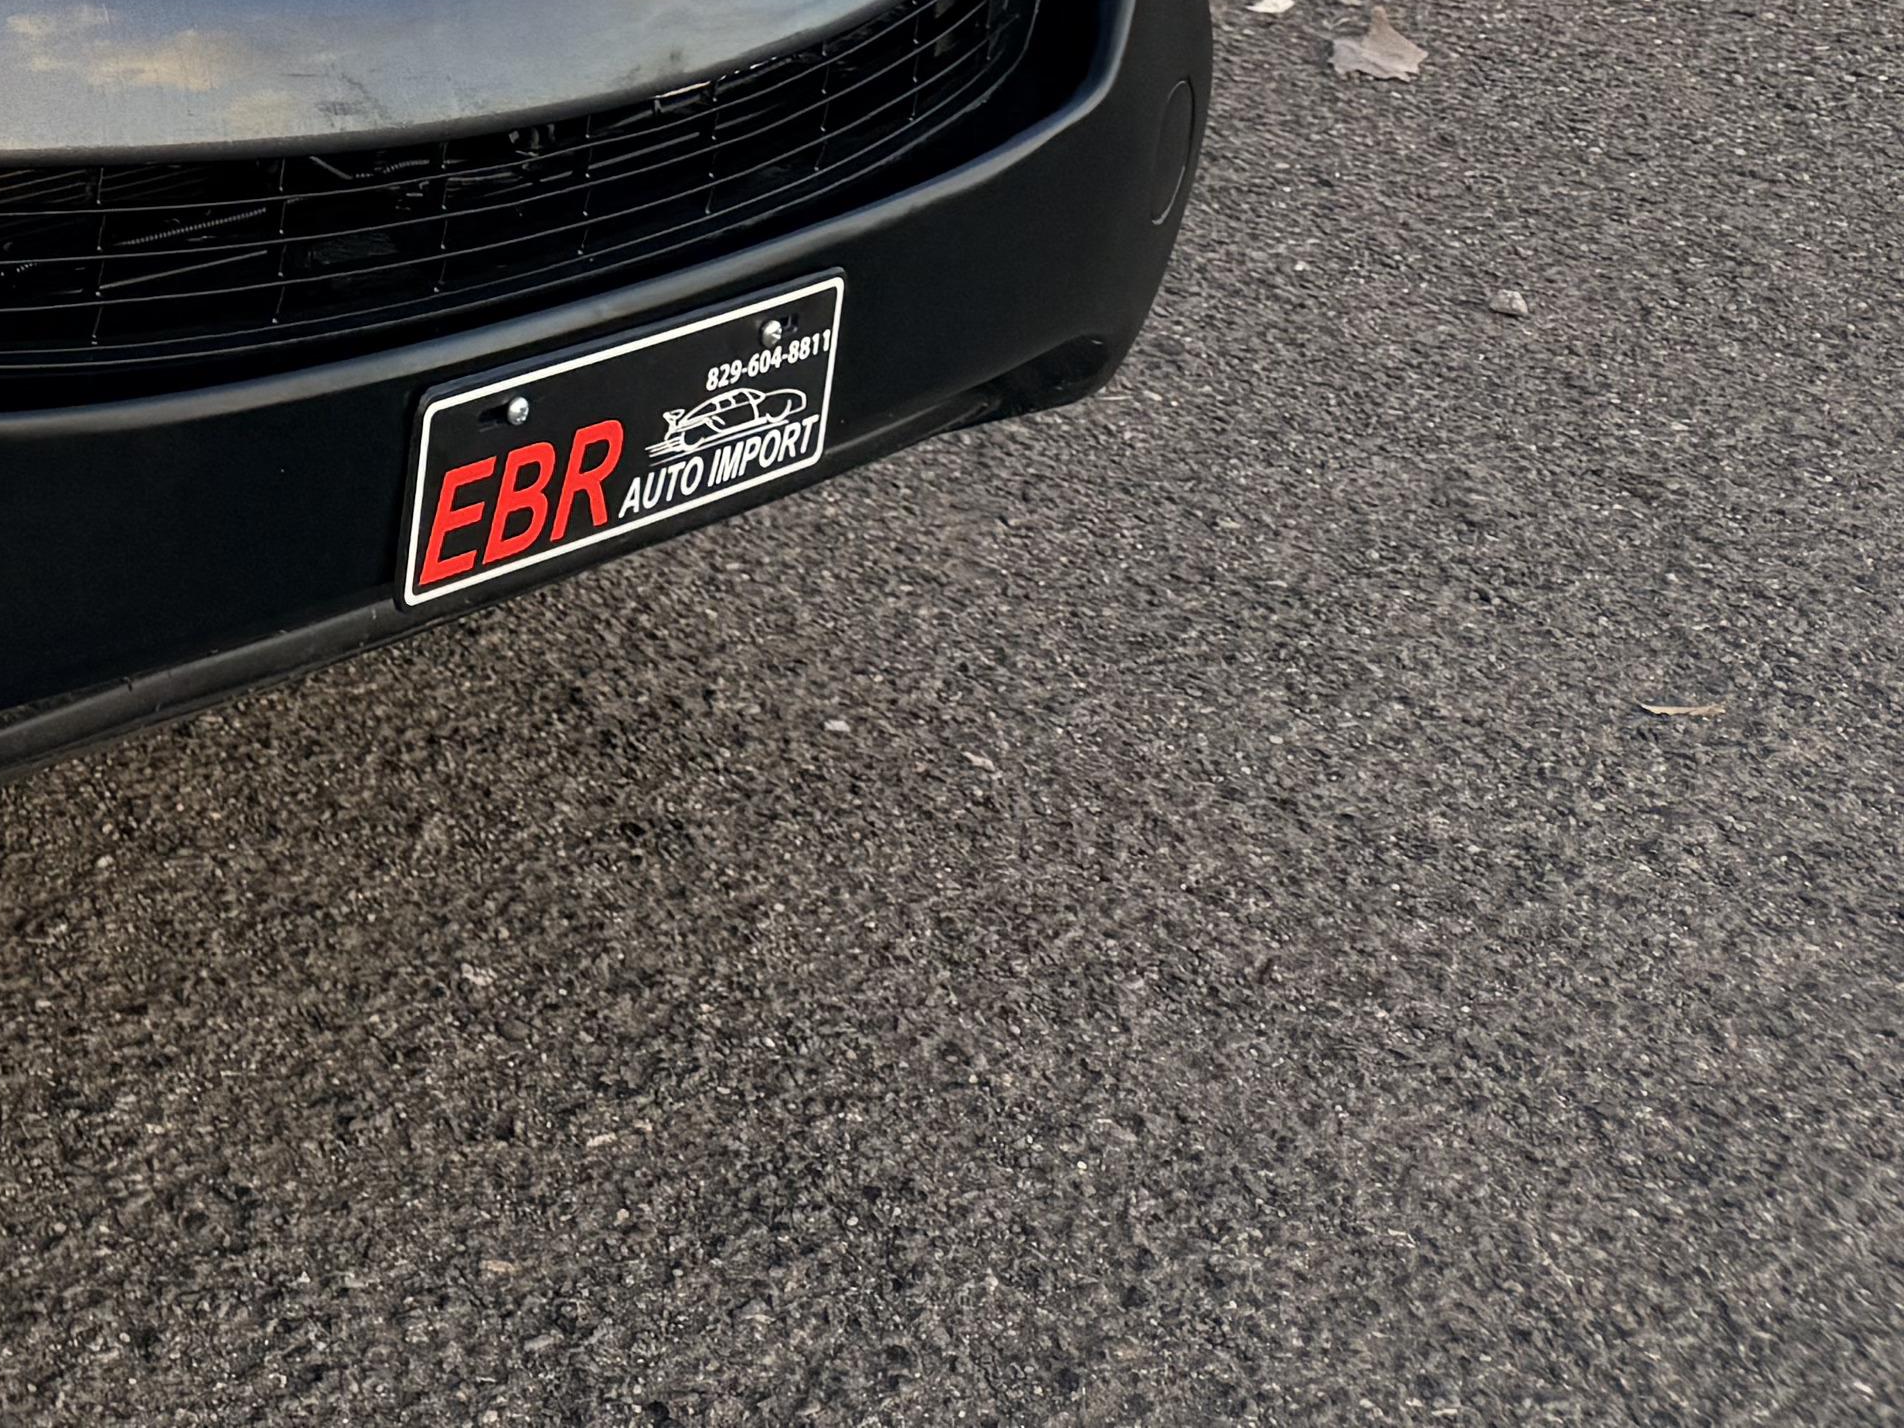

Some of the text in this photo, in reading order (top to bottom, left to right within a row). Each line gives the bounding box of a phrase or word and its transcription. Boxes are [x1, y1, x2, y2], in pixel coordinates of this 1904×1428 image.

[706, 328, 832, 392] 829-604-8811
[419, 419, 624, 586] EBR
[618, 414, 820, 519] AUTO IMPORT
